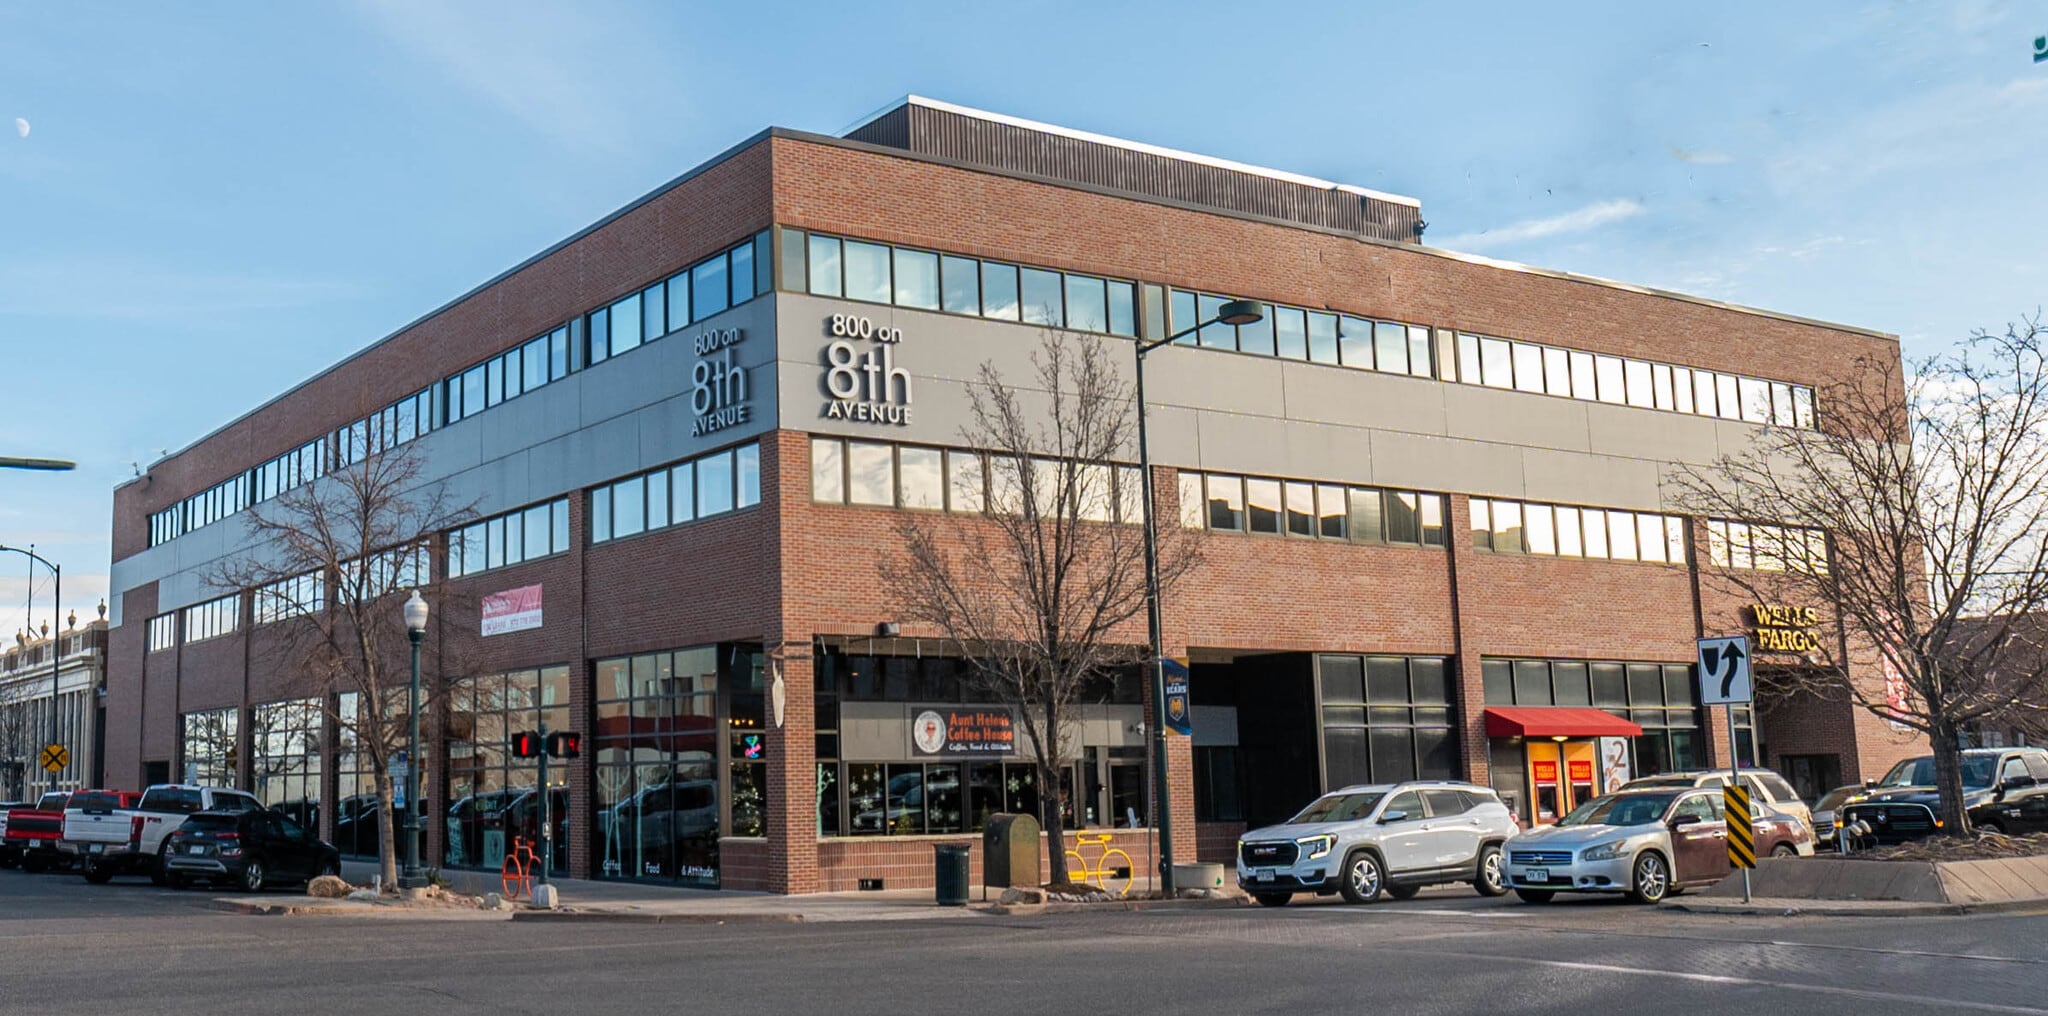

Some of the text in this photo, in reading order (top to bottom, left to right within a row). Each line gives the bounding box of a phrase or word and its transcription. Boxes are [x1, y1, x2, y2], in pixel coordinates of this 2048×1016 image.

[832, 313, 902, 342] 800 on
[694, 327, 739, 357] 800 on
[691, 347, 744, 415] 8th
[827, 341, 912, 403] 8th
[691, 405, 747, 437] AVENUE
[828, 400, 912, 425] AVENUE
[1753, 604, 1818, 626] WELLS
[1757, 629, 1818, 651] FARGO
[949, 712, 974, 726] Aunt
[947, 727, 1013, 741] Coffee House
[645, 861, 660, 874] Food
